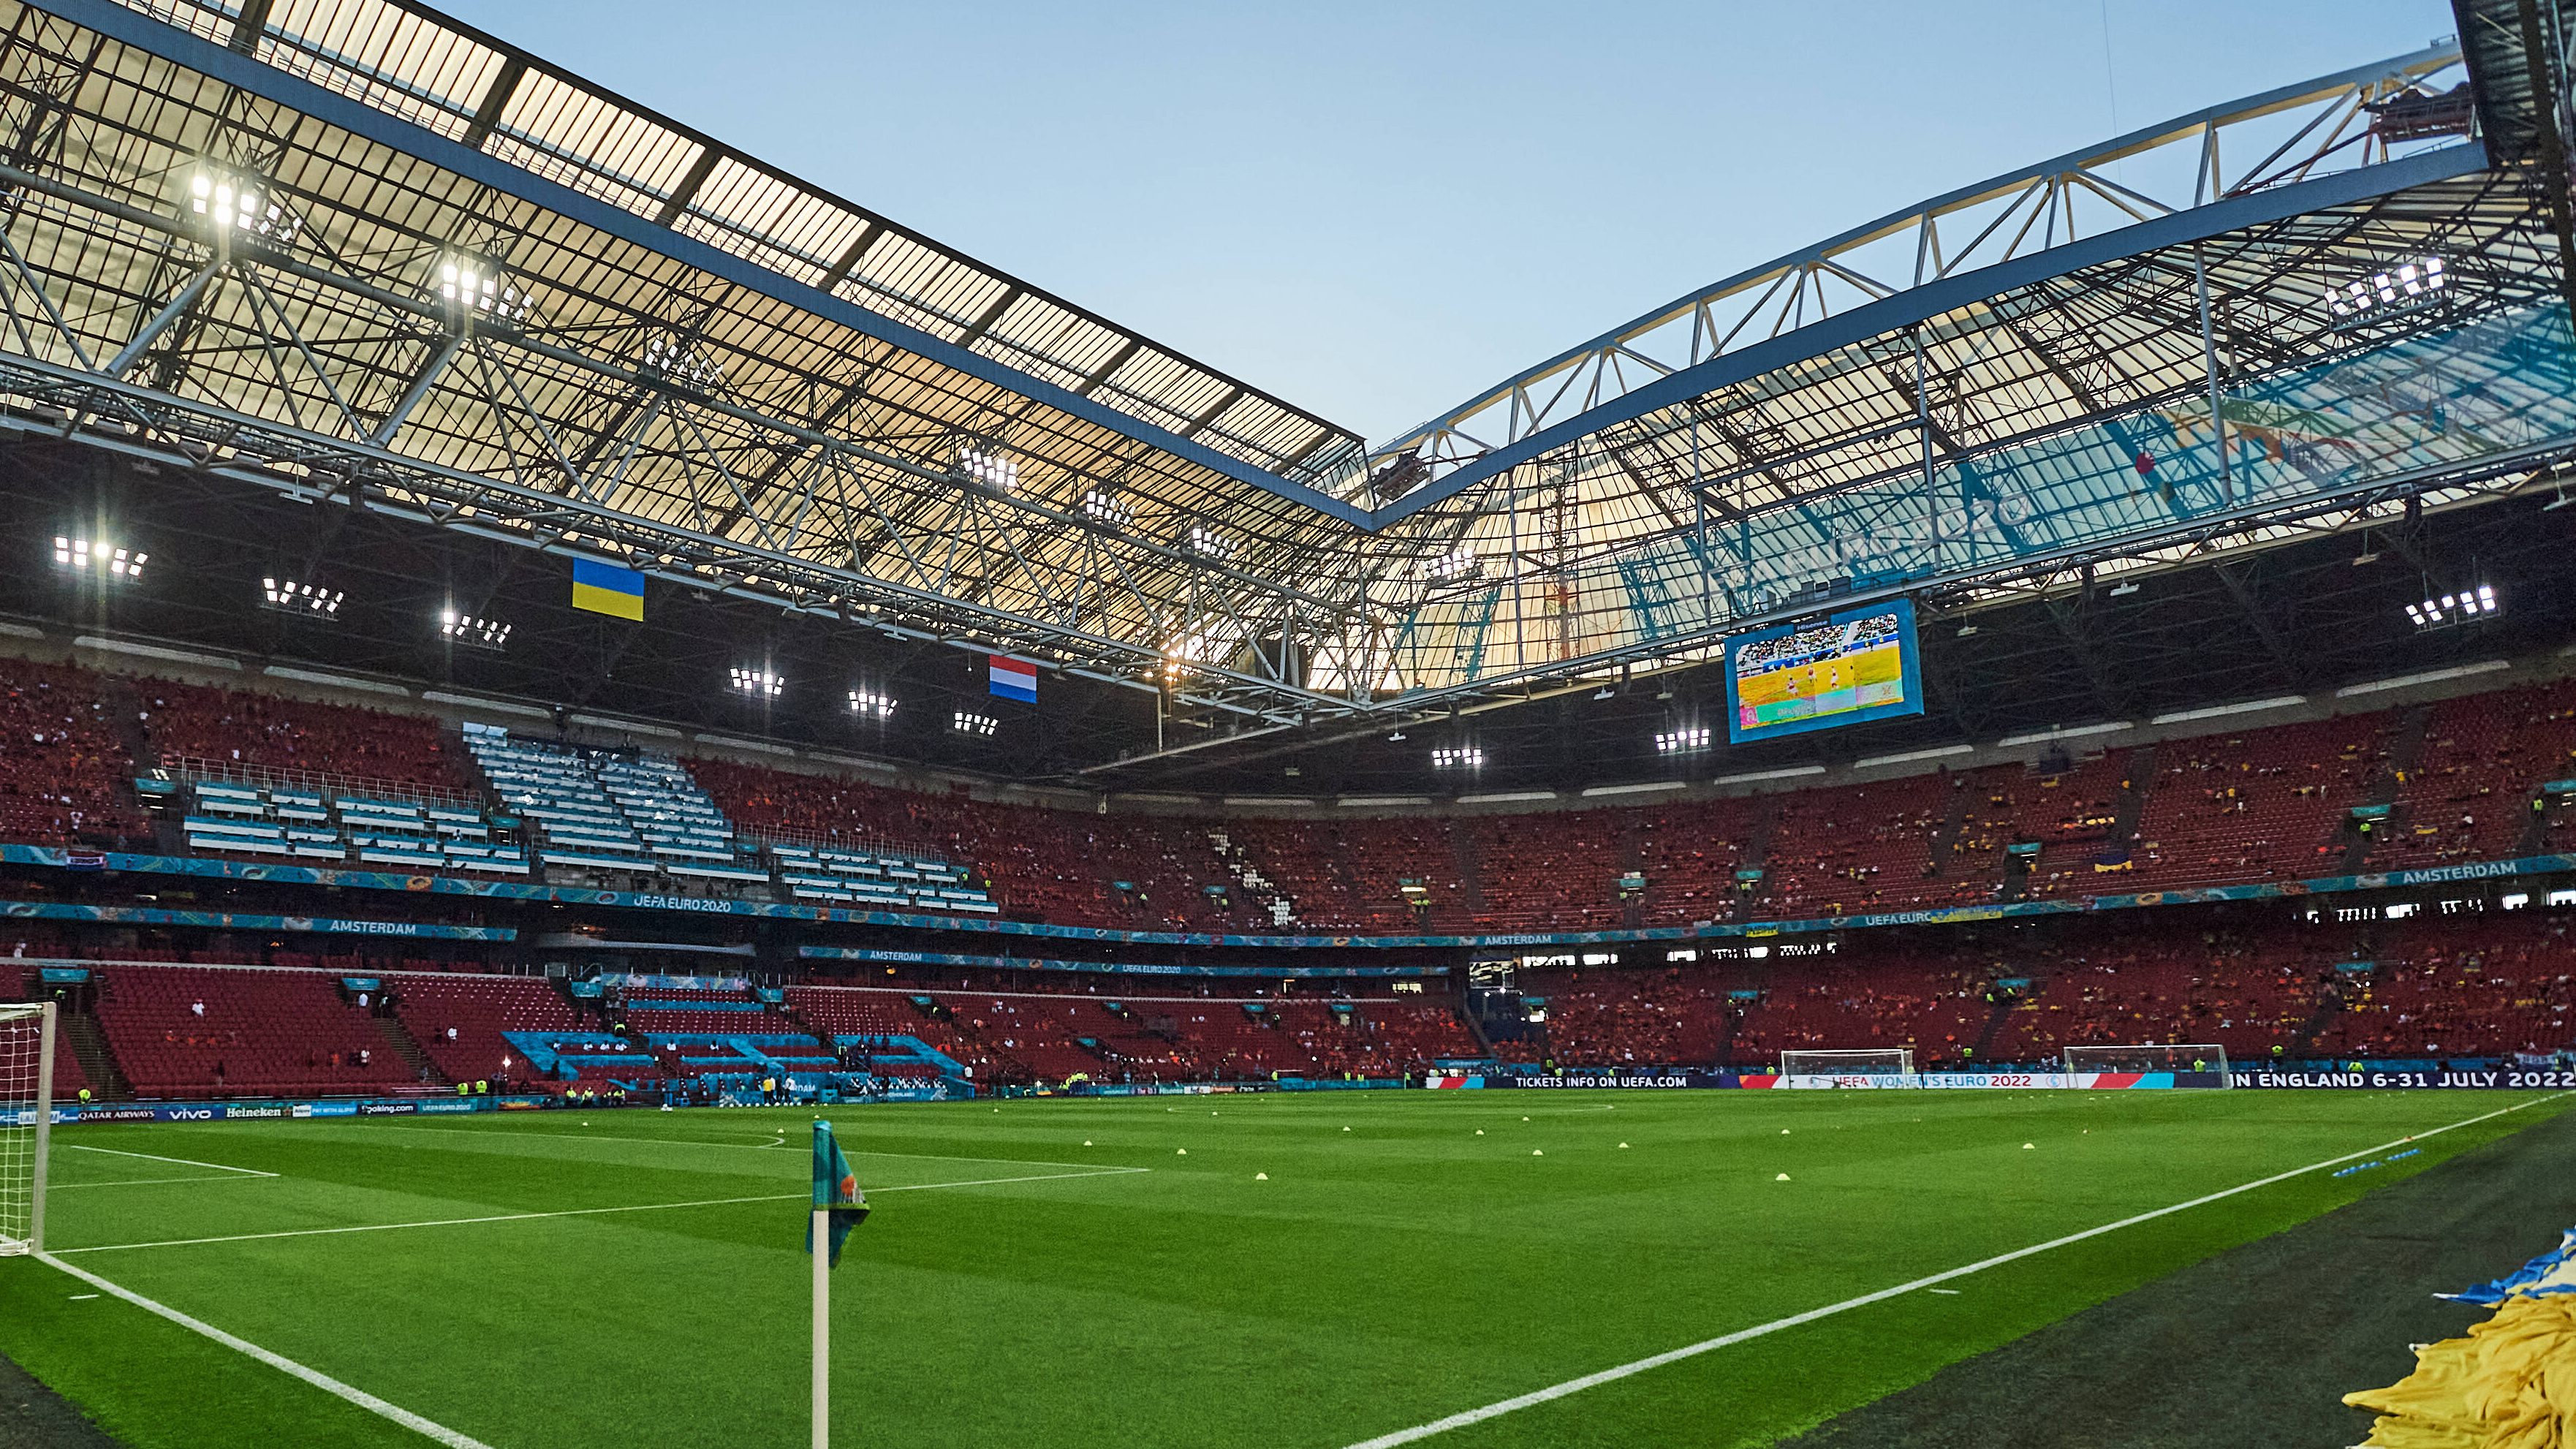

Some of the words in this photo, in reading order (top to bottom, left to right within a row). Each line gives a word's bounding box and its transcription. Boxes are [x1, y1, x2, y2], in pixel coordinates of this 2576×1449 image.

[2403, 862, 2517, 884] AMSTERDAM
[634, 895, 666, 908] UEFA
[668, 897, 700, 911] EURO
[702, 899, 731, 912] 2020
[1865, 915, 1898, 926] UEFA
[330, 920, 416, 935] AMSTERDAM
[1485, 934, 1552, 945] AMSTERDAM
[870, 950, 922, 962] AMSTERDAM
[1516, 1077, 1563, 1087] TICKETS
[1567, 1077, 1595, 1087] INFO
[1599, 1077, 1617, 1087] ON
[1621, 1077, 1687, 1087] UEFA.COM
[1833, 1076, 1868, 1087] UEFA
[1945, 1076, 1987, 1086] EURO
[1991, 1075, 2031, 1086] 2022
[2258, 1073, 2364, 1087] ENGLAND
[2373, 1073, 2428, 1087] 6-31
[2437, 1072, 2498, 1087] JULY
[2508, 1072, 2576, 1087] 2022
[78, 1111, 112, 1120] QATAR
[113, 1109, 155, 1119] AIRWAYS
[169, 1108, 212, 1119] vivo
[227, 1108, 281, 1117] Heineken
